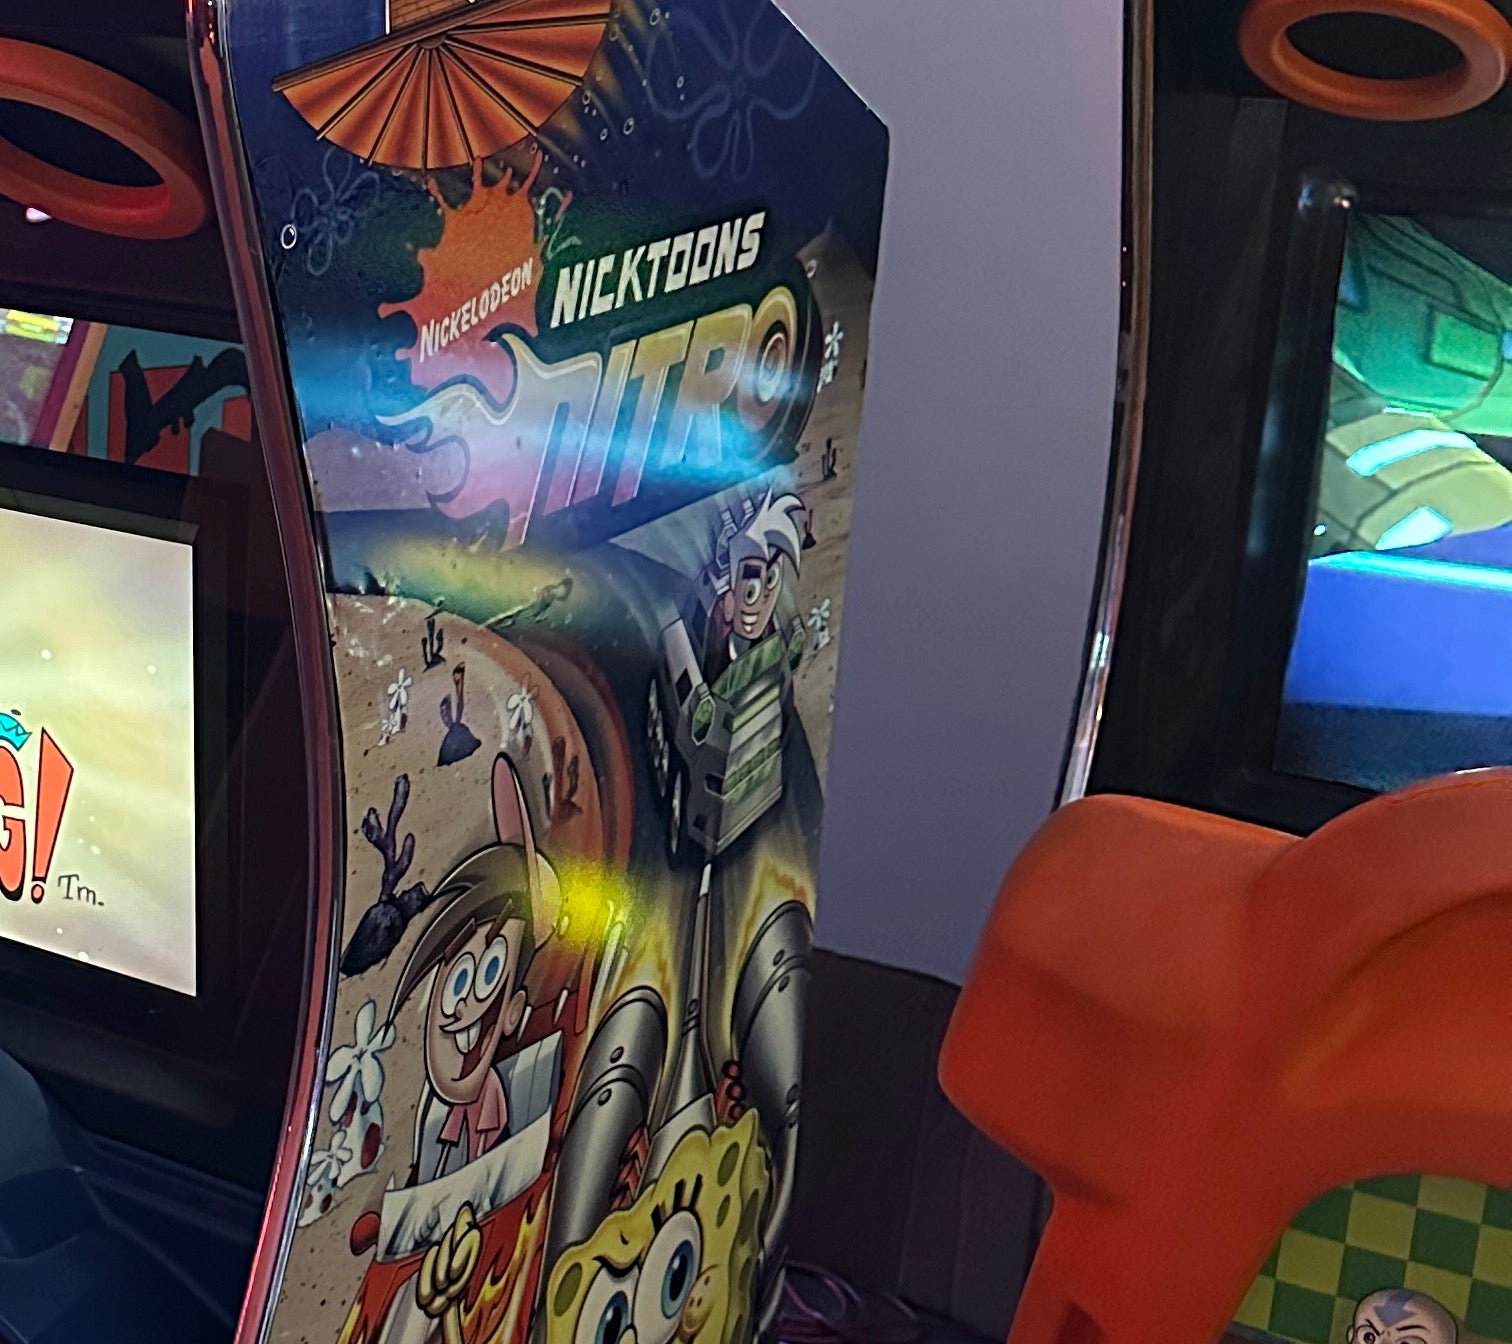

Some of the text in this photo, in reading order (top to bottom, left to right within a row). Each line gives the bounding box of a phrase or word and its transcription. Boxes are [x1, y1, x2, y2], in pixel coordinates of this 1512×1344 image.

[418, 256, 534, 362] NICKELODEON
[548, 211, 767, 329] NICKTOONS
[498, 286, 800, 552] NITRO
